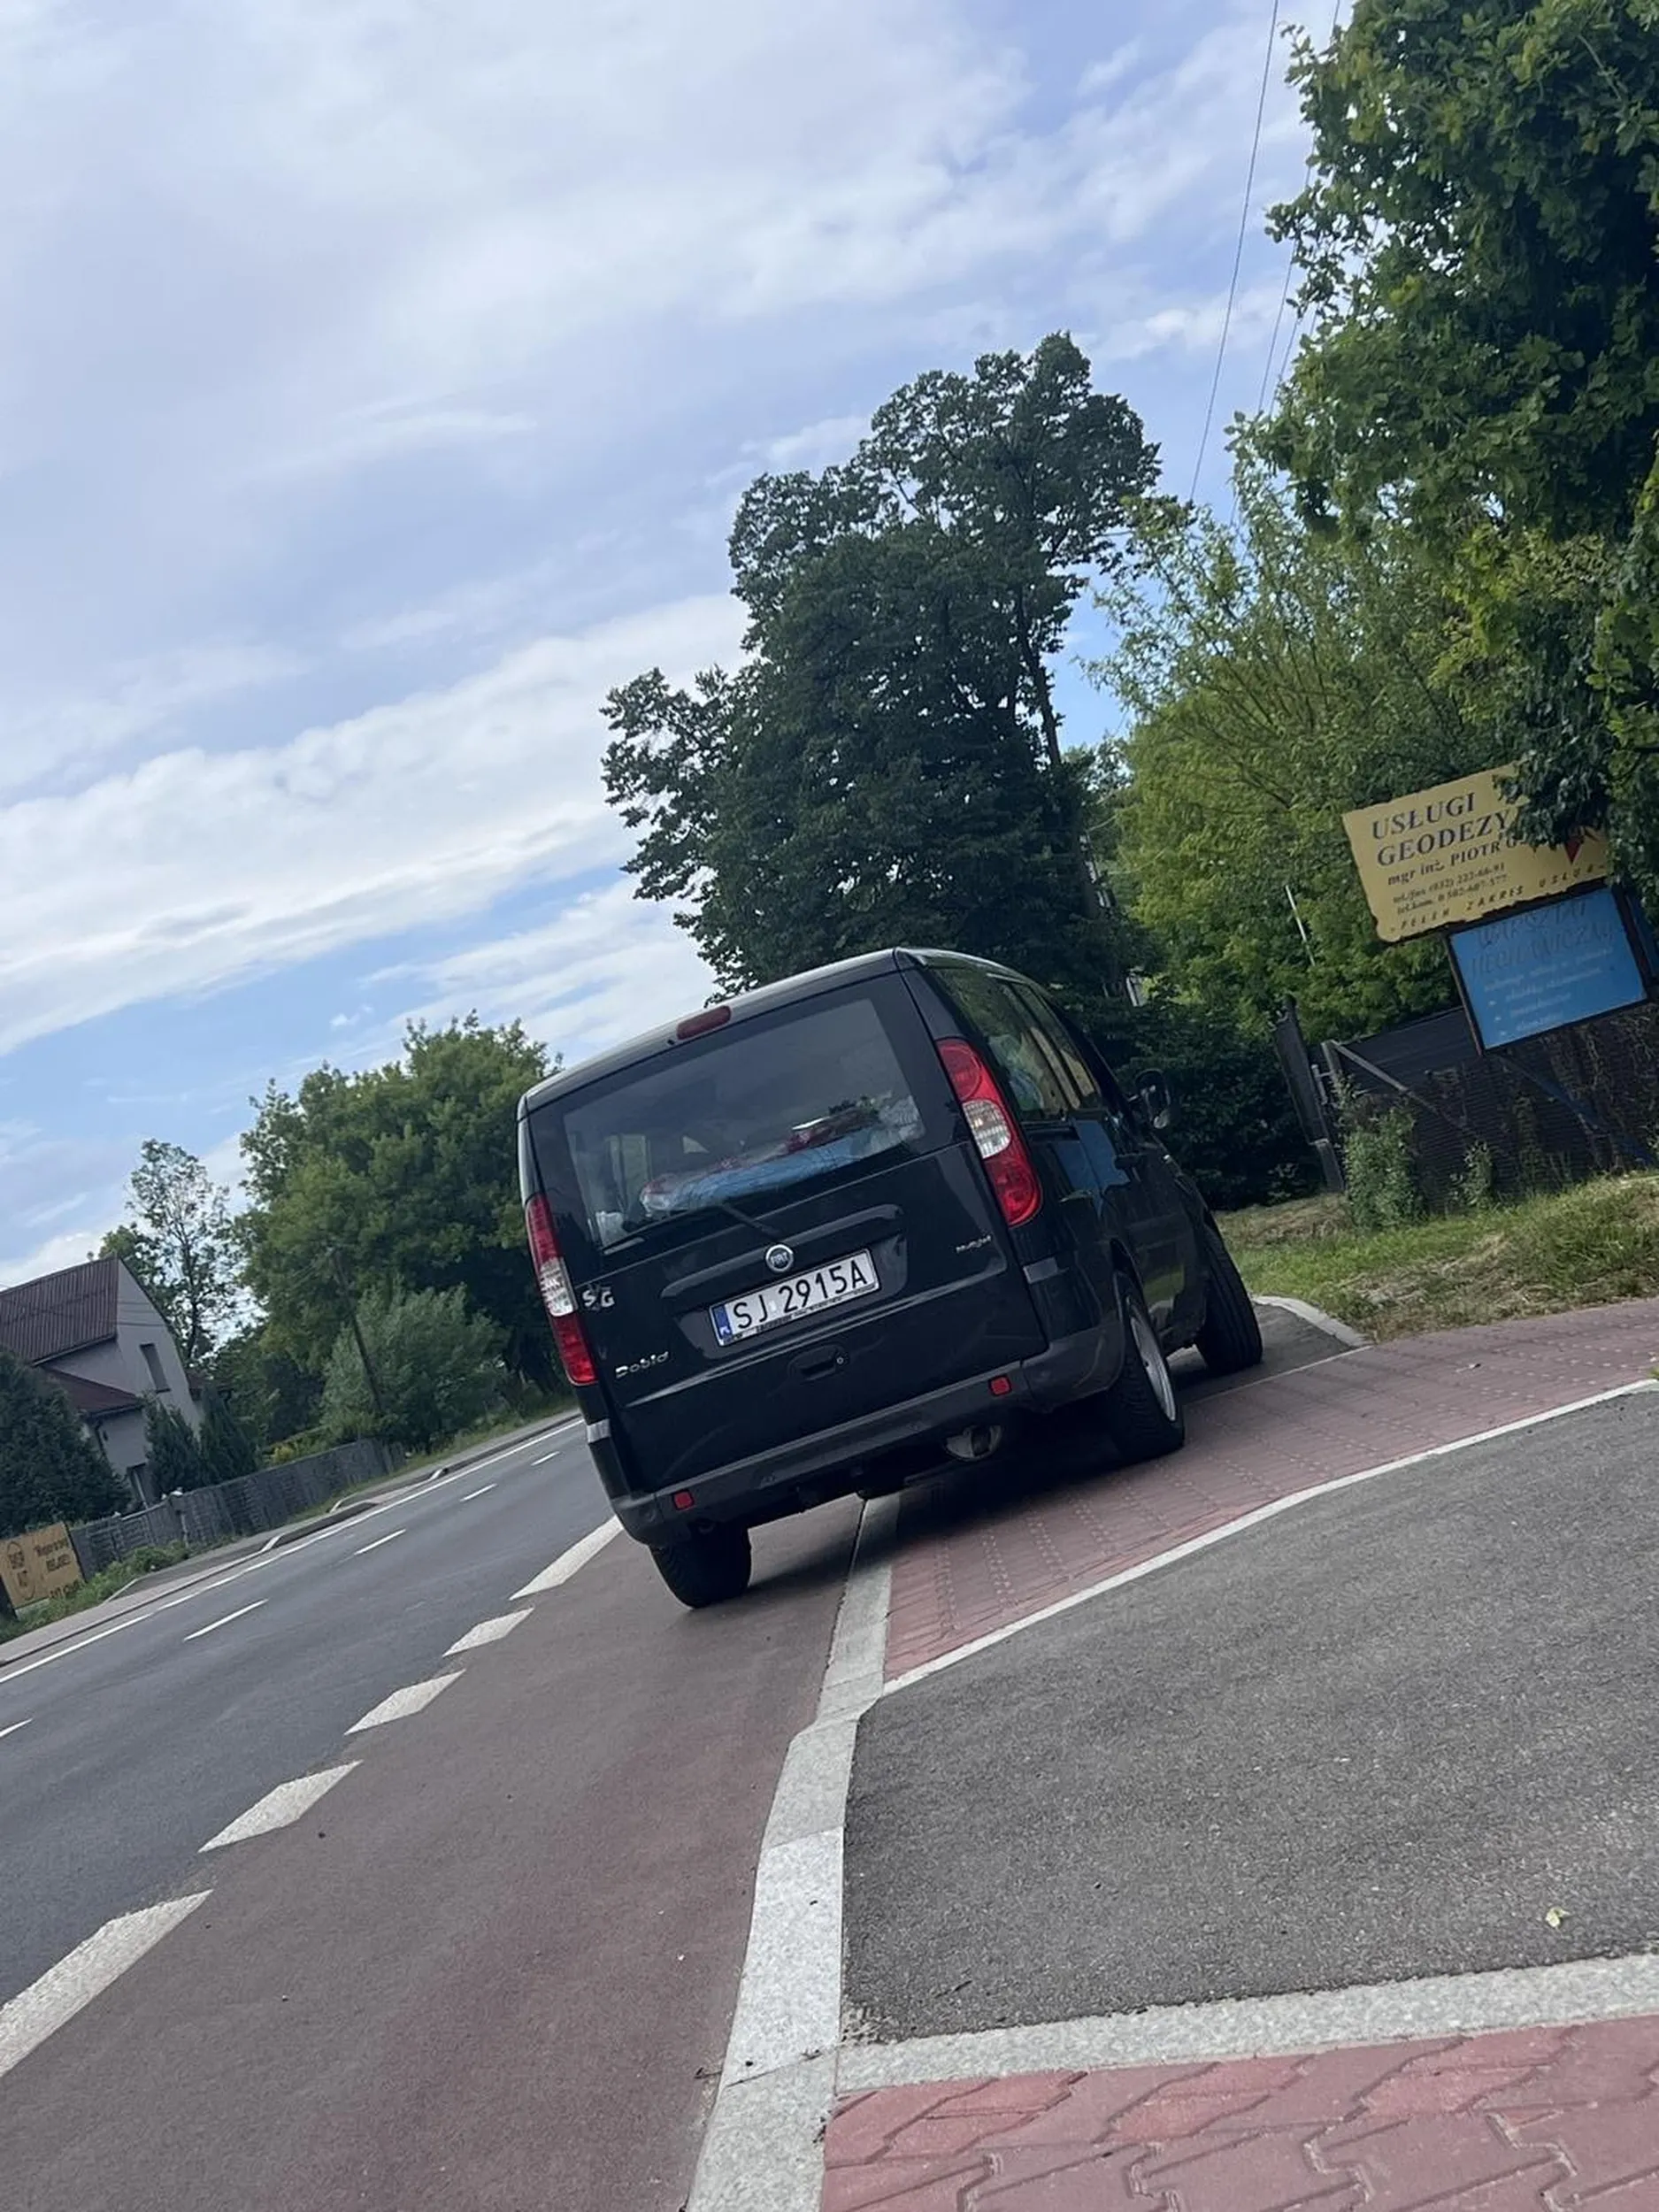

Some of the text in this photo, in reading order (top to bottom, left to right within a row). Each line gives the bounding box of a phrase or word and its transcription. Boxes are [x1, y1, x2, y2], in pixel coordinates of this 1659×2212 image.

[1373, 792, 1475, 840] USŁUGI
[1378, 809, 1512, 866] GEODEZY
[1387, 870, 1416, 885] mgr
[1450, 841, 1501, 867] PIOTR
[771, 1251, 788, 1266] FIAT
[733, 1294, 768, 1329] SJ
[778, 1259, 868, 1314] 2915A
